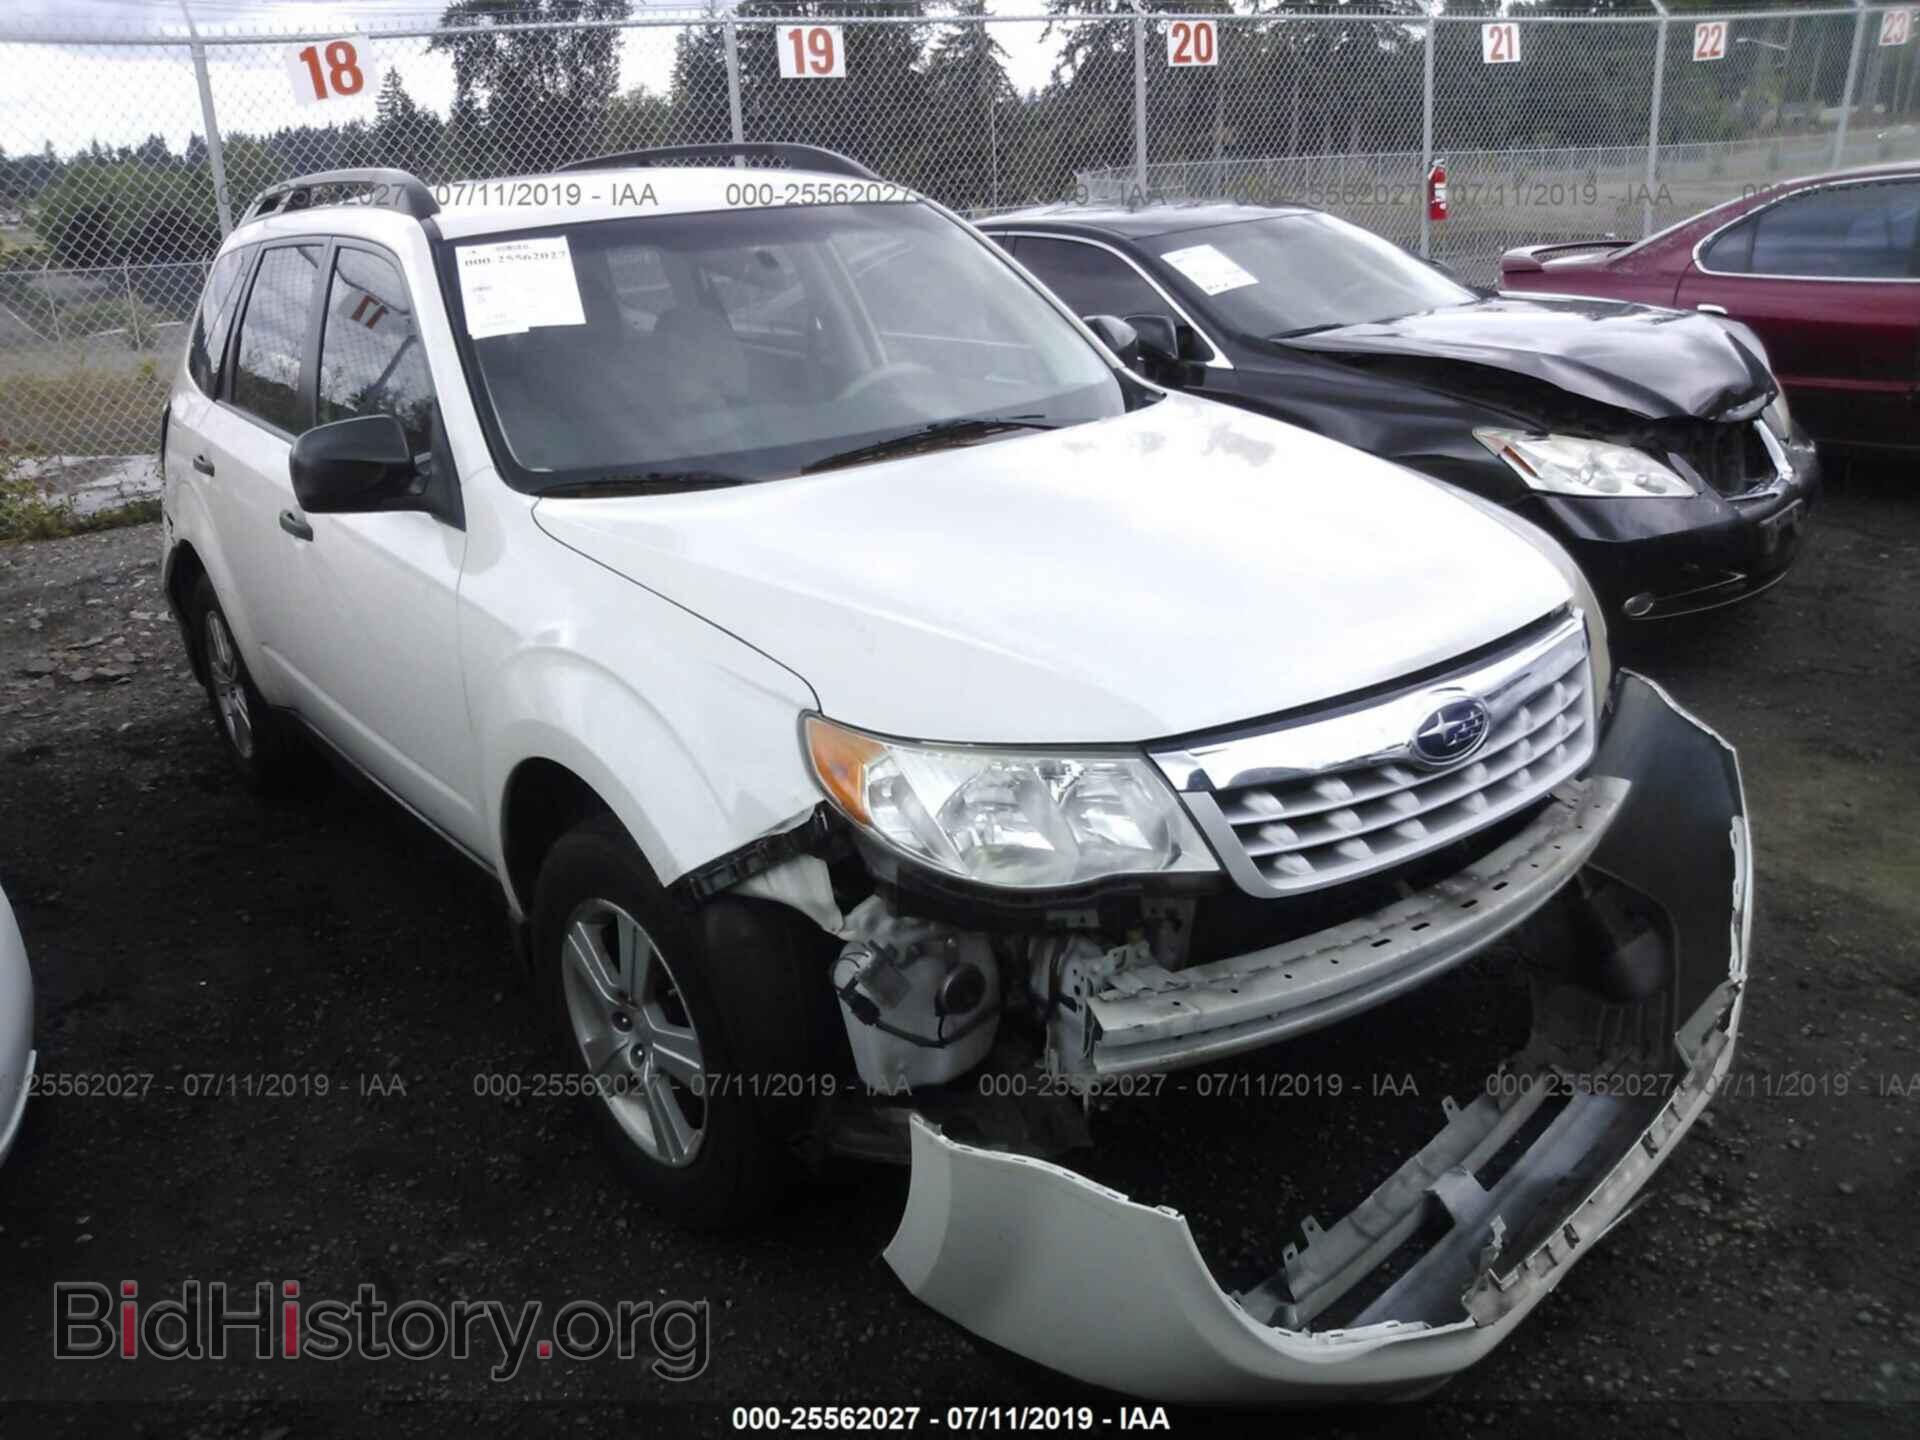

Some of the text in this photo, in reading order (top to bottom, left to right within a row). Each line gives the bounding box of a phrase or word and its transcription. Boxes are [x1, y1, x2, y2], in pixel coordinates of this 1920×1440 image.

[1172, 22, 1213, 64] 20
[1489, 26, 1513, 61] 21
[1696, 25, 1723, 58] 22
[1882, 12, 1905, 44] 23
[788, 27, 834, 75] 19
[299, 41, 364, 101] 18
